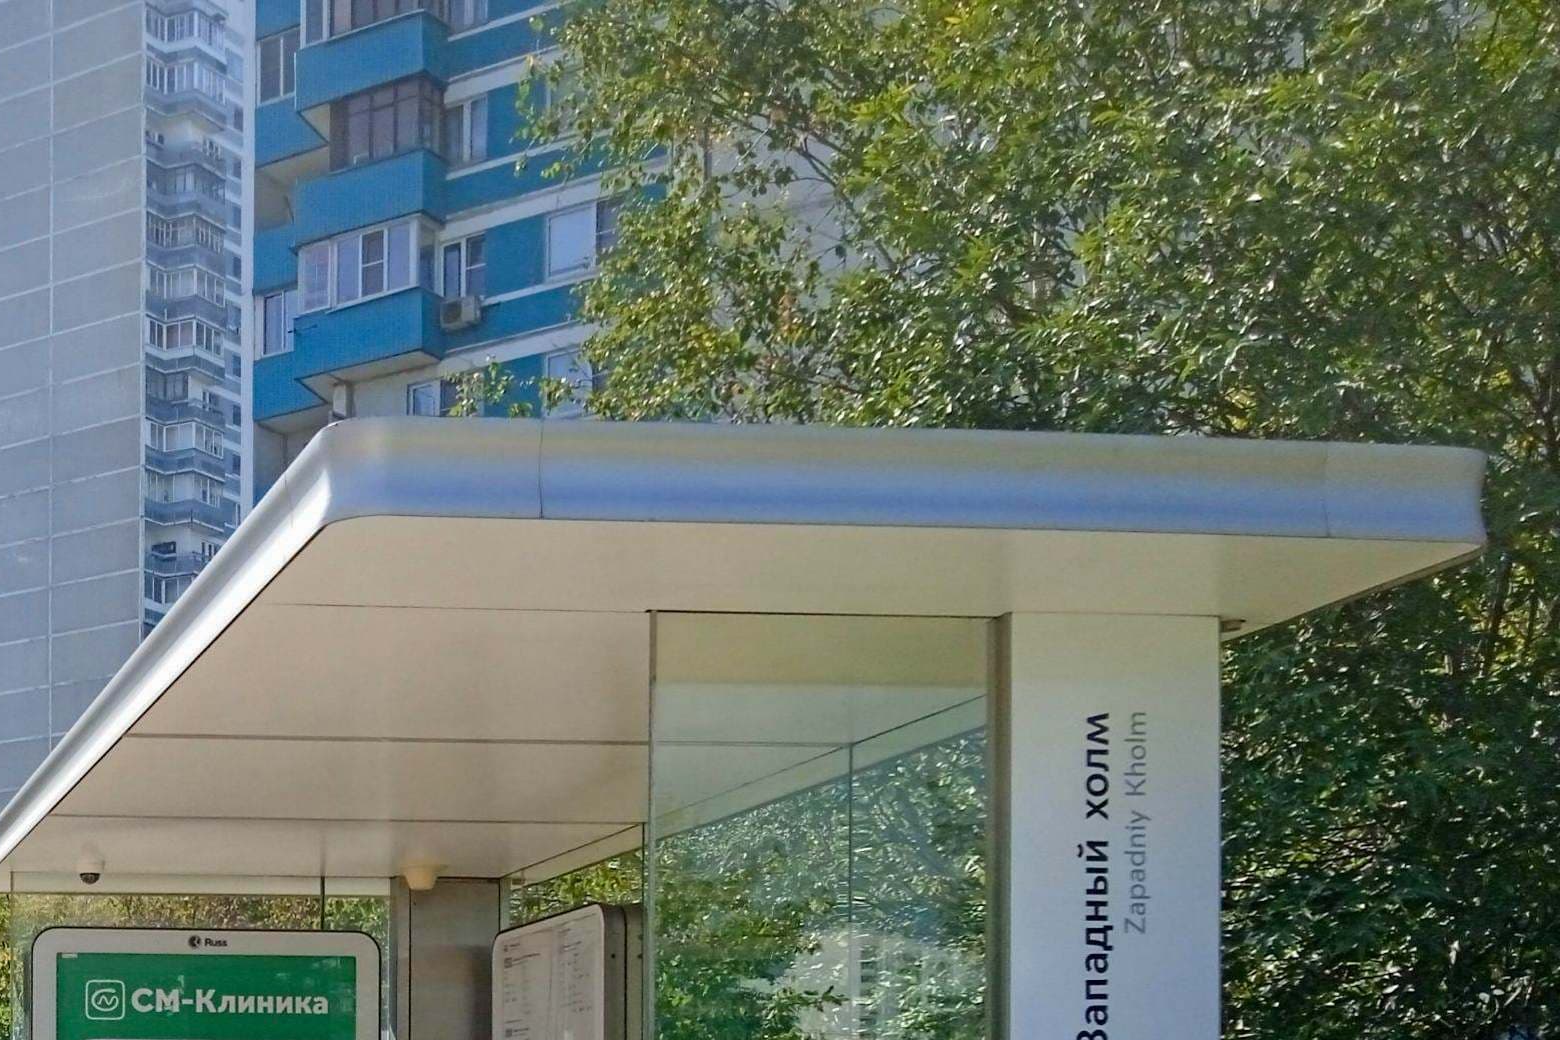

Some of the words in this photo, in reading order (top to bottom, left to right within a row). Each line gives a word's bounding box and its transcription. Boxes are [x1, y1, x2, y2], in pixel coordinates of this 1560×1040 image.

[1085, 712, 1110, 820] холм
[1123, 710, 1148, 796] Kholm
[1123, 809, 1152, 935] Zapadniy
[130, 986, 329, 1015] СМ-Клиника
